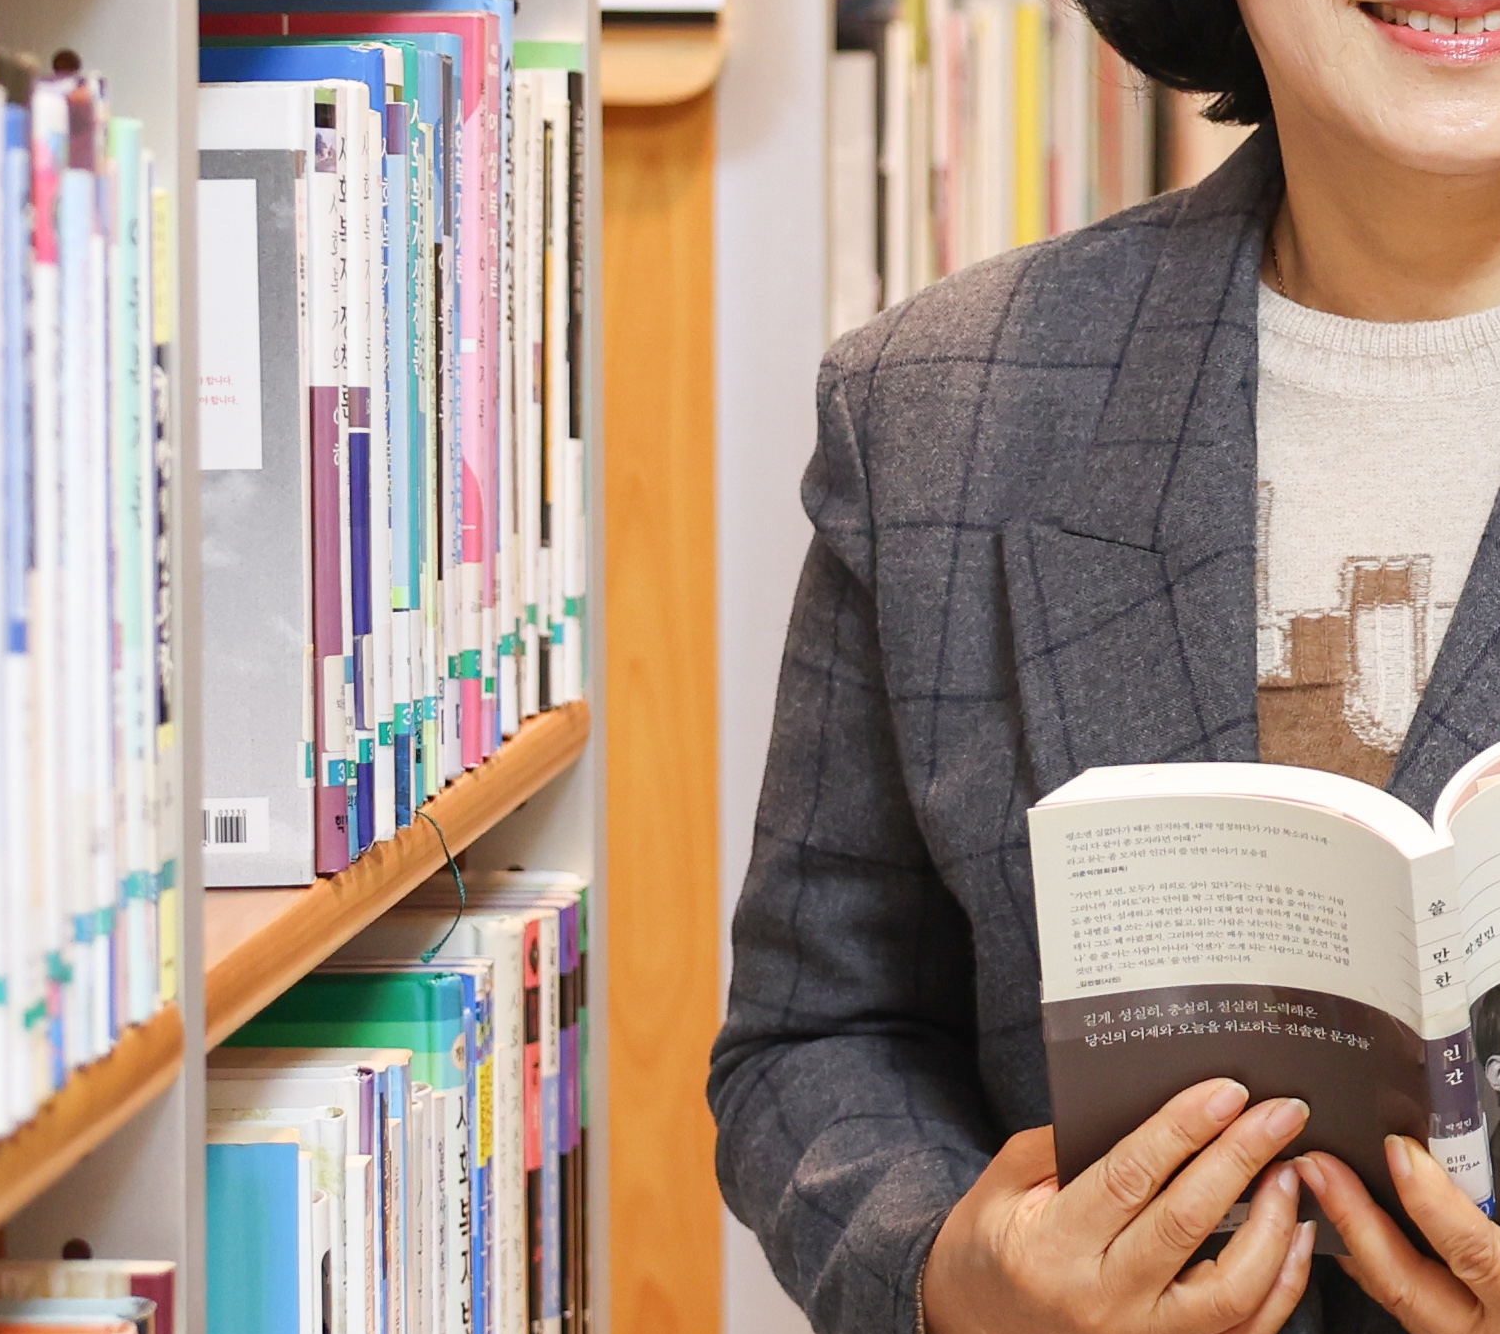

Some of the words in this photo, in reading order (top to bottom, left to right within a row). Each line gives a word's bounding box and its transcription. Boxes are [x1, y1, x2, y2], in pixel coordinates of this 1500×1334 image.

[1428, 899, 1446, 916] 쓸
[1465, 926, 1495, 956] 박정민
[1118, 1003, 1163, 1022] 성실히,
[1168, 1000, 1214, 1017] 충실히,
[1085, 1029, 1127, 1048] 당신의
[1130, 1024, 1174, 1042] 어제와
[1177, 1020, 1220, 1035] 오늘을
[1224, 1020, 1281, 1035] 위로하는
[1284, 1024, 1328, 1041] 진솔한
[1447, 1154, 1467, 1165] 818
